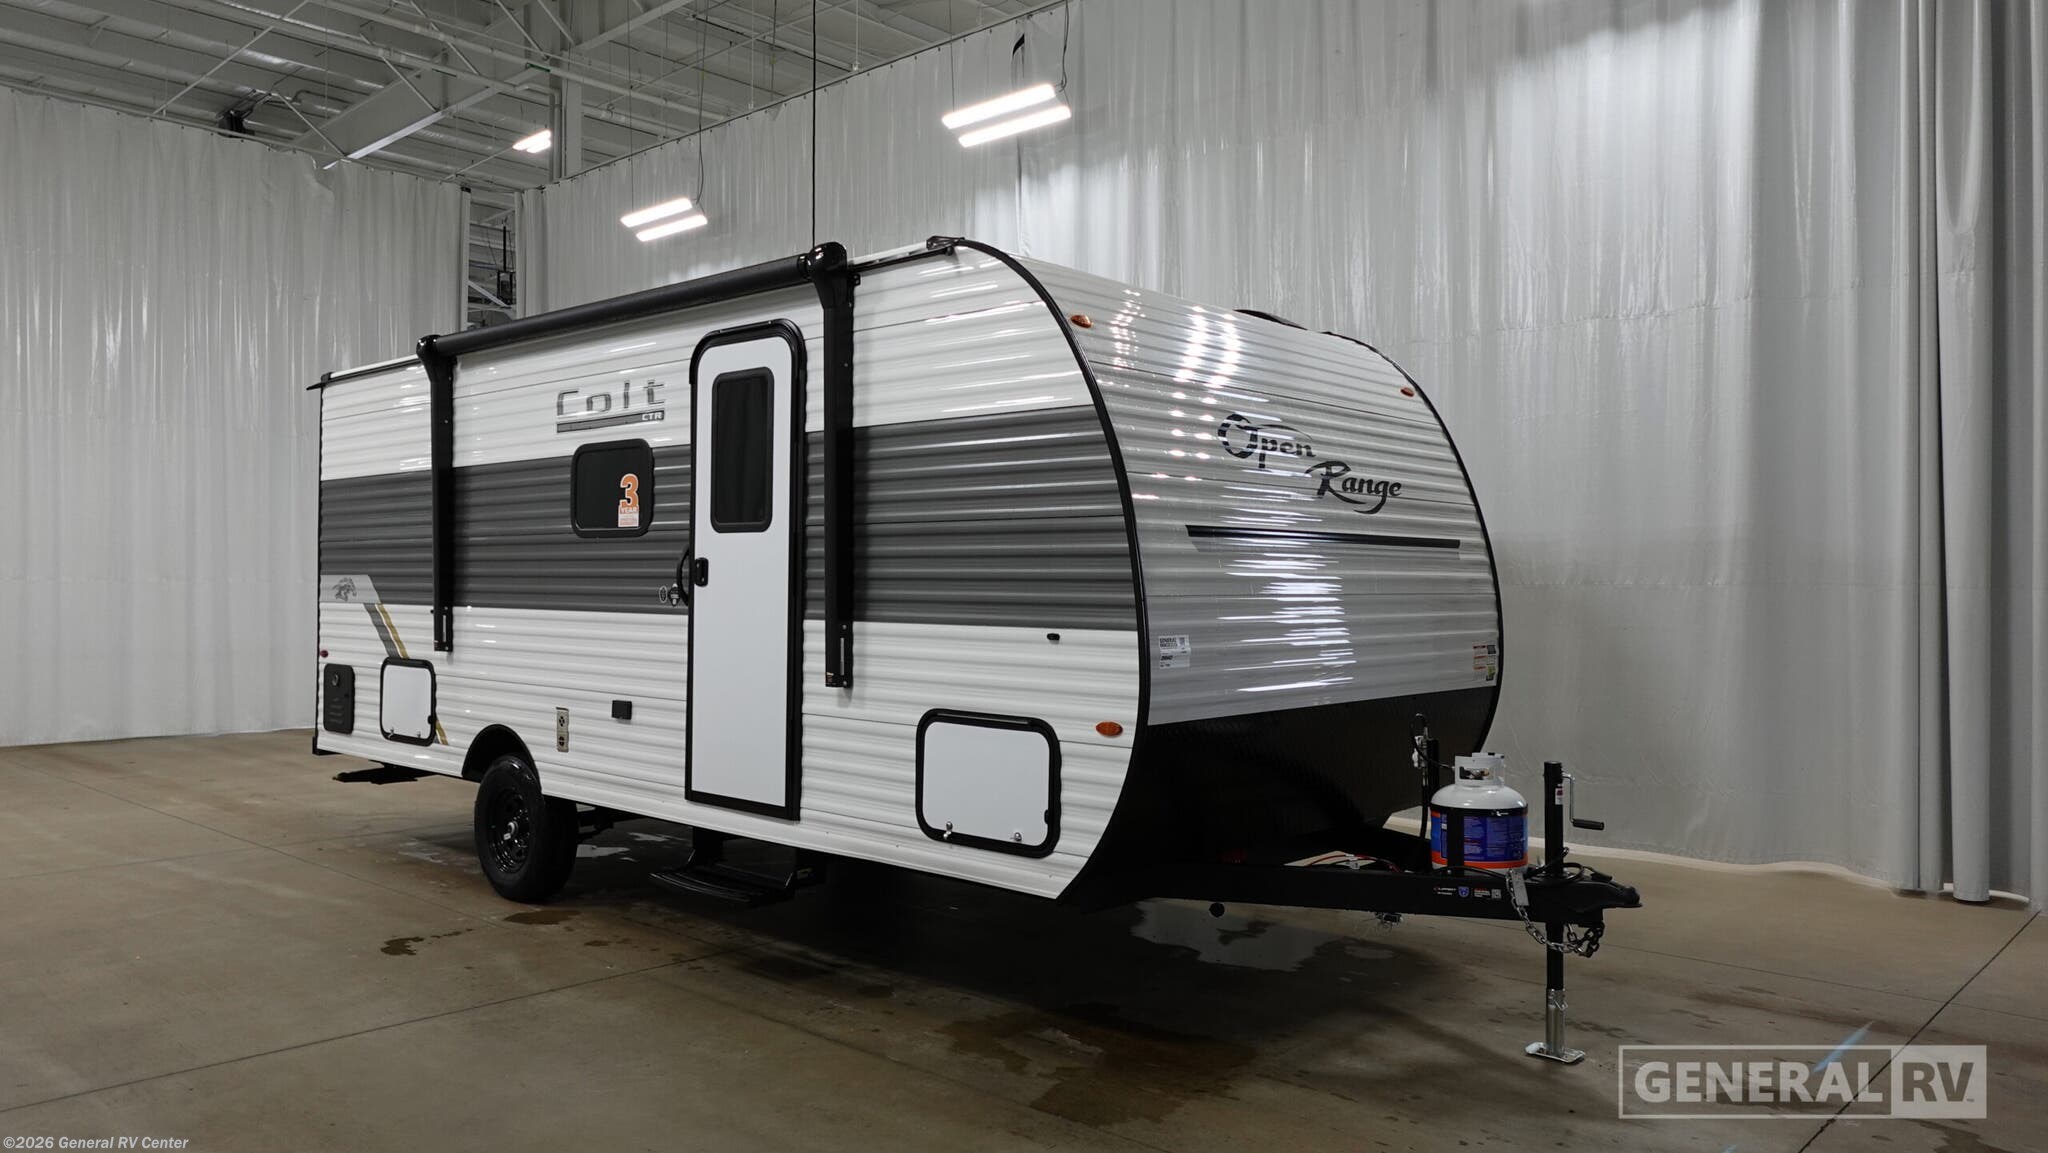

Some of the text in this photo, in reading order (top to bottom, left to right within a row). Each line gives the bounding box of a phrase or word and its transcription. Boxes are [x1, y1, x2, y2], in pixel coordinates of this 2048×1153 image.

[556, 380, 665, 416] Colt
[641, 411, 663, 421] CTR
[1217, 413, 1316, 469] Open
[620, 473, 639, 507] 3
[1304, 460, 1402, 515] Range
